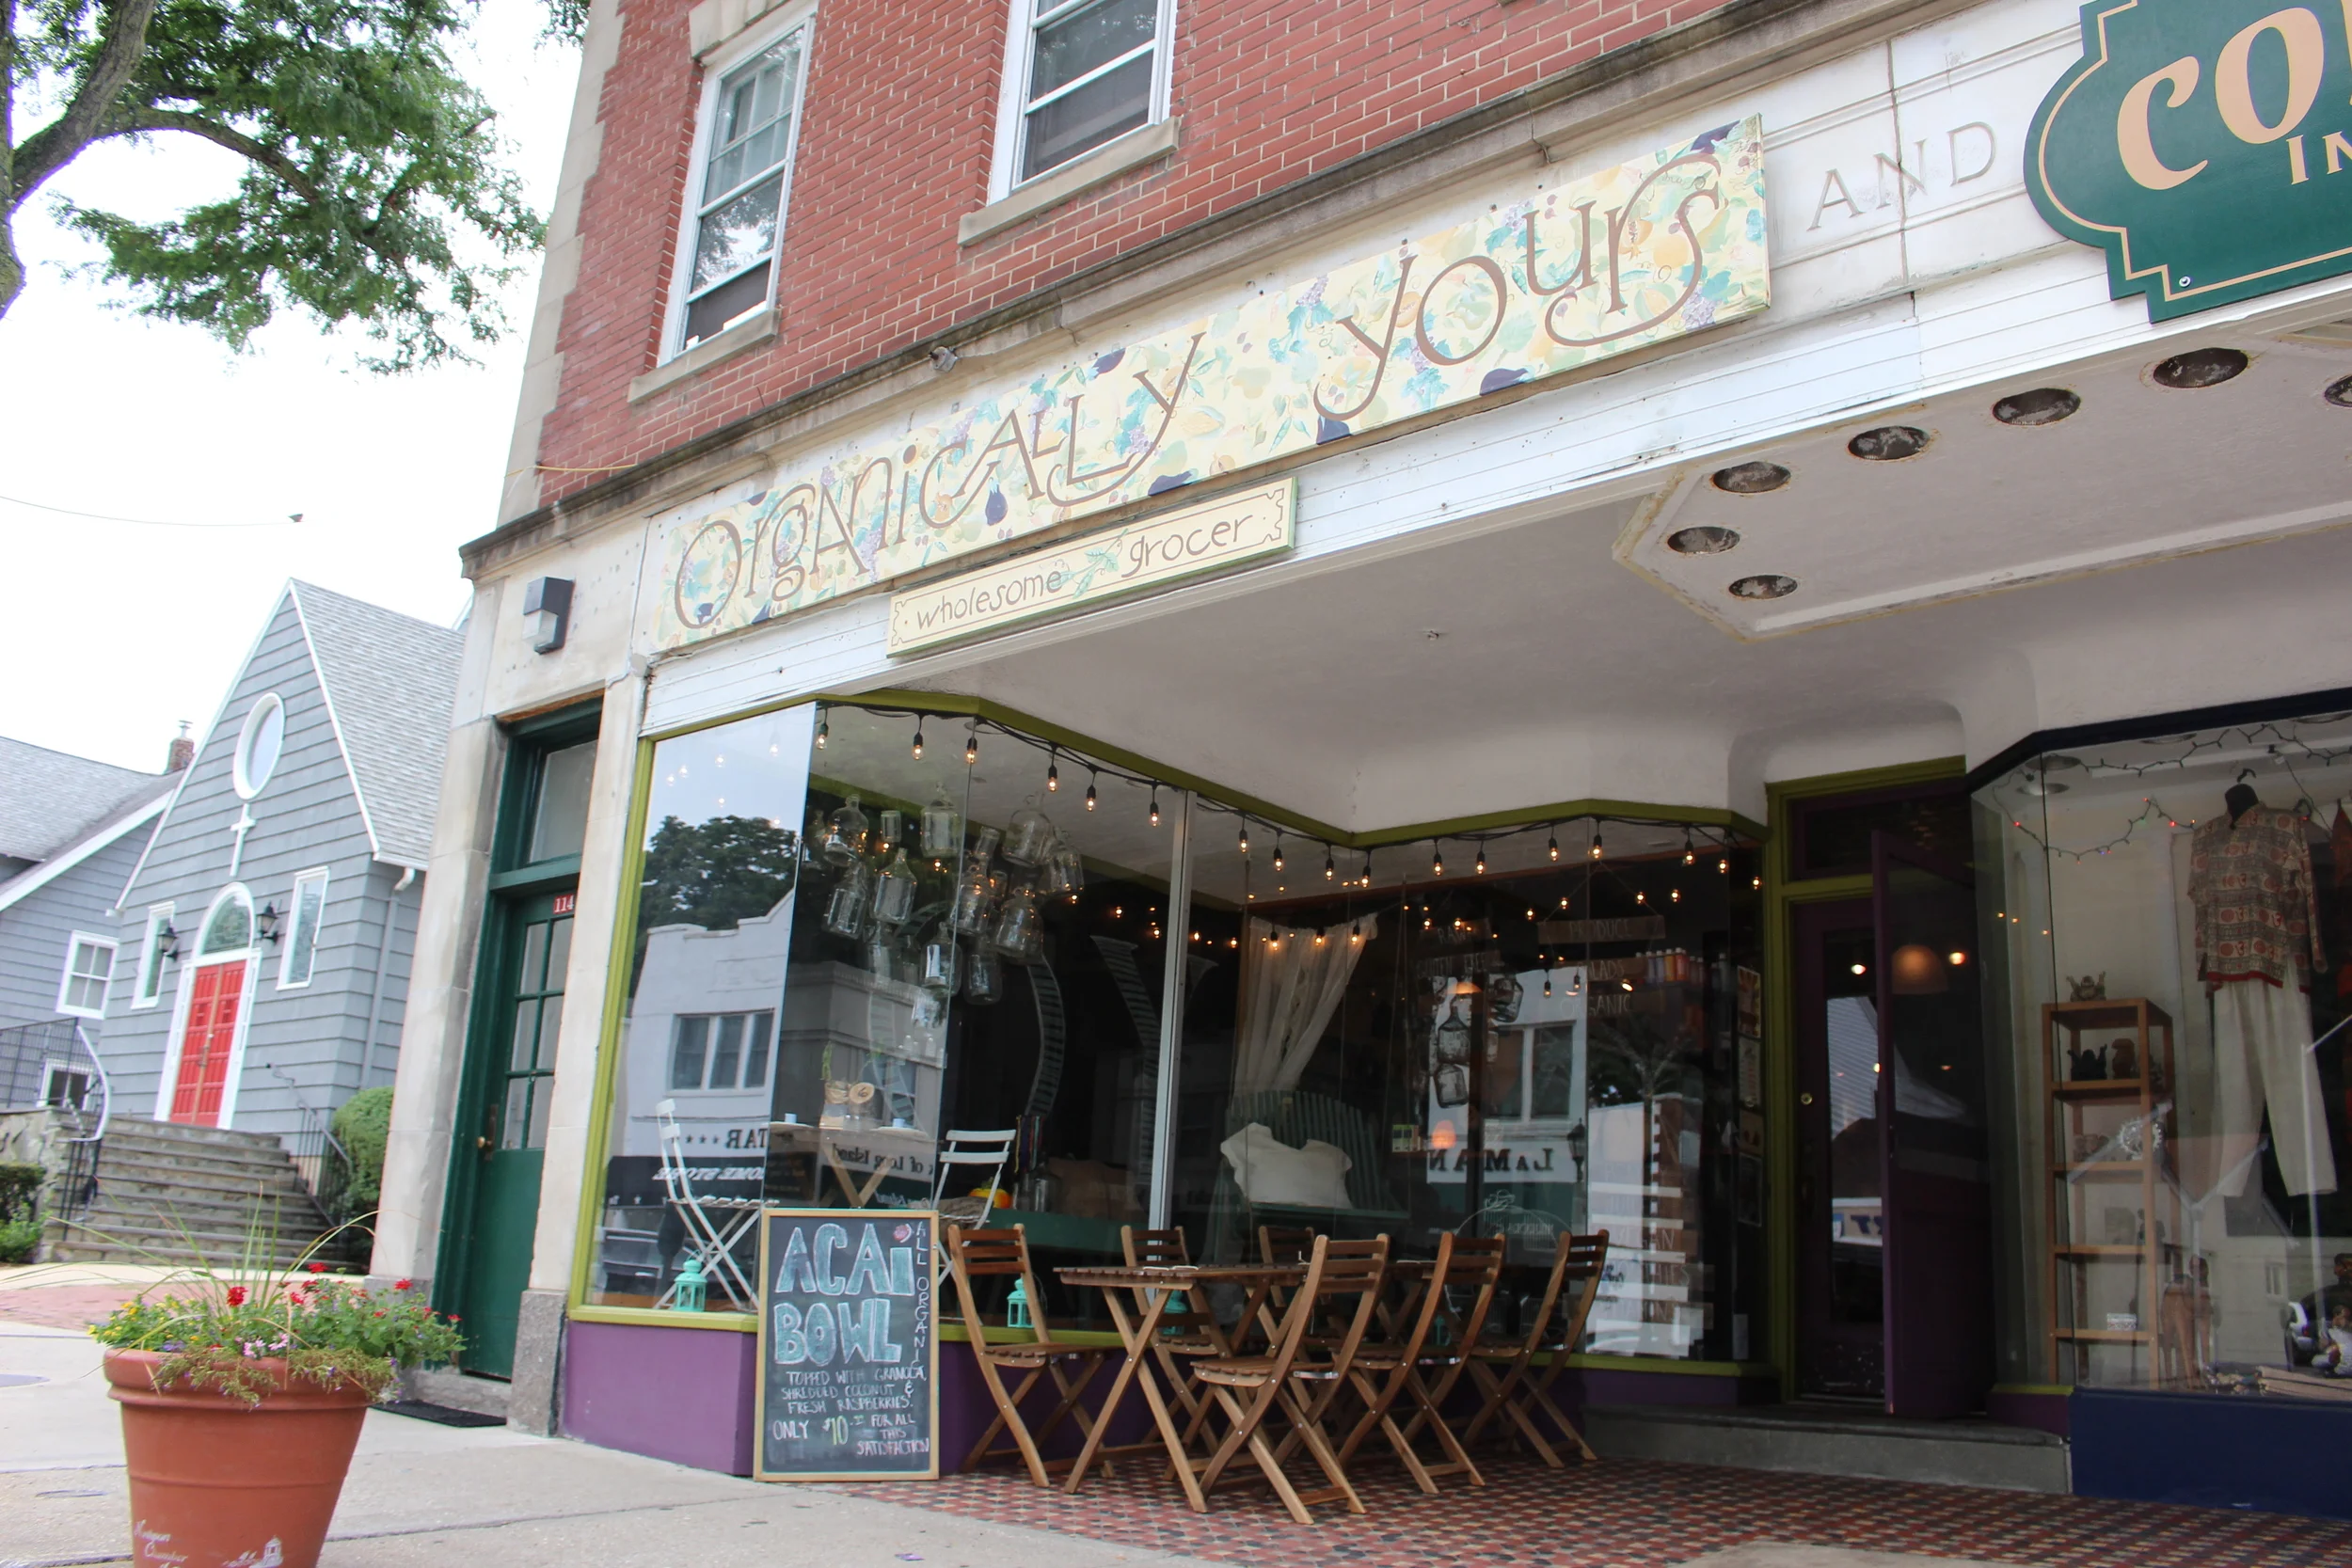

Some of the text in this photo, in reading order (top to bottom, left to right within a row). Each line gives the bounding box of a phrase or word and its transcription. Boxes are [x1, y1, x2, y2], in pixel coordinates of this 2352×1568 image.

[2117, 0, 2352, 190] CO
[1806, 120, 1995, 231] AND
[915, 514, 1254, 630] wholesome grocer
[554, 895, 575, 913] 114
[773, 1298, 903, 1366] BOWL
[772, 1420, 809, 1441] ONLY
[870, 1414, 893, 1427] FOR
[895, 1413, 916, 1426] ALL
[787, 1400, 827, 1415] FRESH
[880, 1429, 908, 1439] THIS
